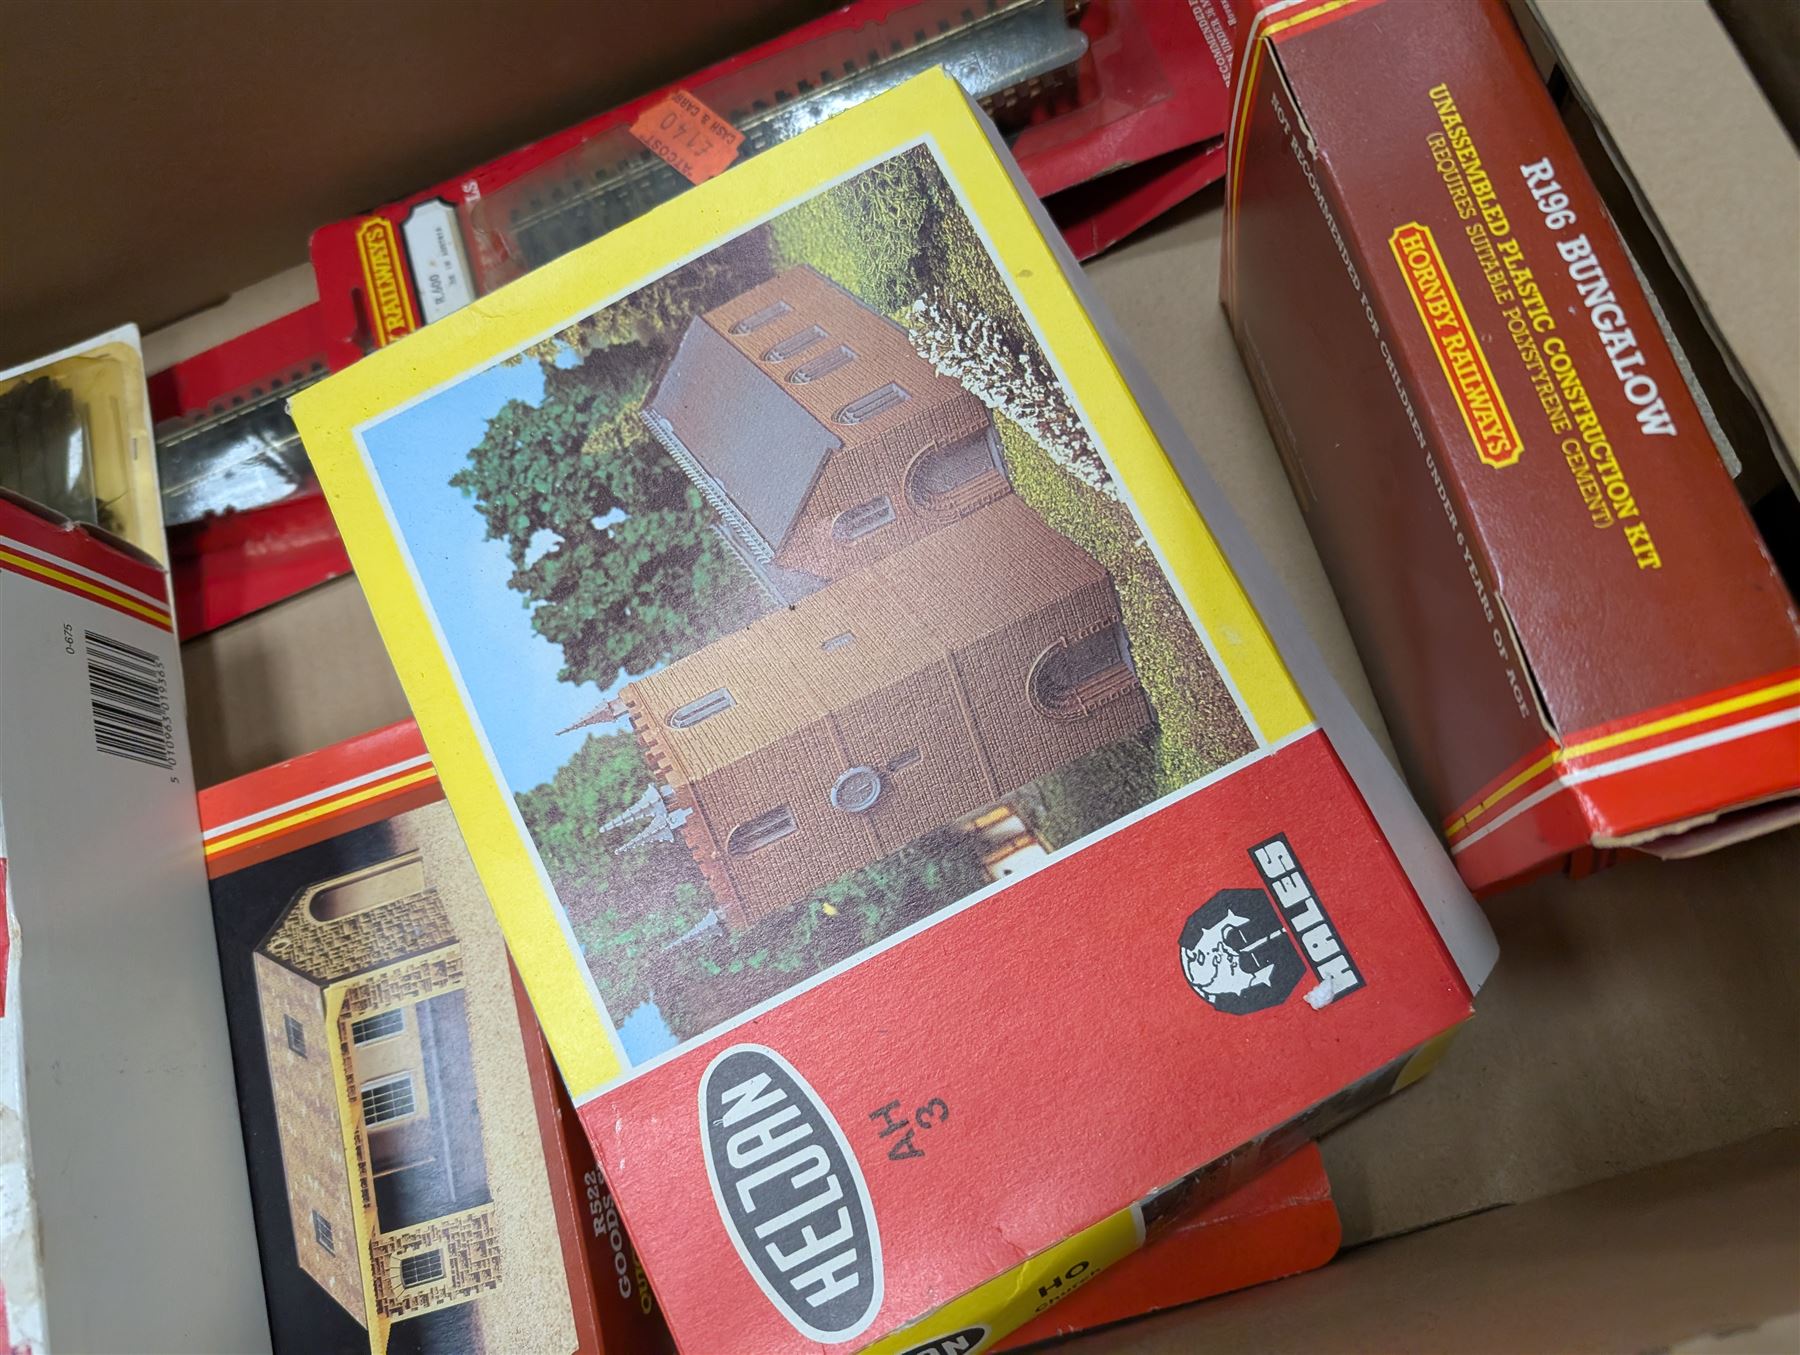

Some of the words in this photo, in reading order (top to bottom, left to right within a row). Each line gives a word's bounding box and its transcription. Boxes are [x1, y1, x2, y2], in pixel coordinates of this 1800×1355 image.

[700, 113, 710, 124] &
[711, 121, 736, 145] CASH
[366, 226, 406, 332] RAILWAYS
[1426, 131, 1477, 220] (REQUIRES
[1466, 223, 1515, 305] SUITABLE
[1503, 306, 1572, 435] POLYSTYRENE
[1561, 437, 1615, 529] CEMENT)
[1428, 82, 1510, 236] UNASSEMBLED
[1497, 238, 1556, 333] PLASTIC
[1543, 337, 1640, 520] CONSTRUCTION
[1624, 521, 1662, 570] KIT
[1520, 155, 1576, 230] R196
[1556, 233, 1678, 436] BUNGALOW
[1399, 232, 1459, 330] HORNBY
[1441, 331, 1511, 456] RAILWAYS
[1270, 92, 1291, 135] NOT
[1290, 135, 1361, 291] RECOMMENDED
[1359, 291, 1381, 339] FOR
[1380, 340, 1427, 449] CHILDREN
[1425, 451, 1458, 530] UNDER
[1456, 531, 1465, 547] 6
[1463, 545, 1494, 624] YEARS
[1493, 628, 1509, 660] OF
[1506, 668, 1530, 720] AGE
[63, 623, 75, 655] 0-675
[170, 776, 180, 784] 5
[1254, 840, 1359, 998] HALES
[868, 1099, 925, 1161] AH
[915, 1097, 949, 1130] 3
[584, 1170, 607, 1238] R522
[720, 1071, 860, 1308] HELJAN
[602, 1193, 632, 1299] GOODS
[1038, 1261, 1090, 1298] HO
